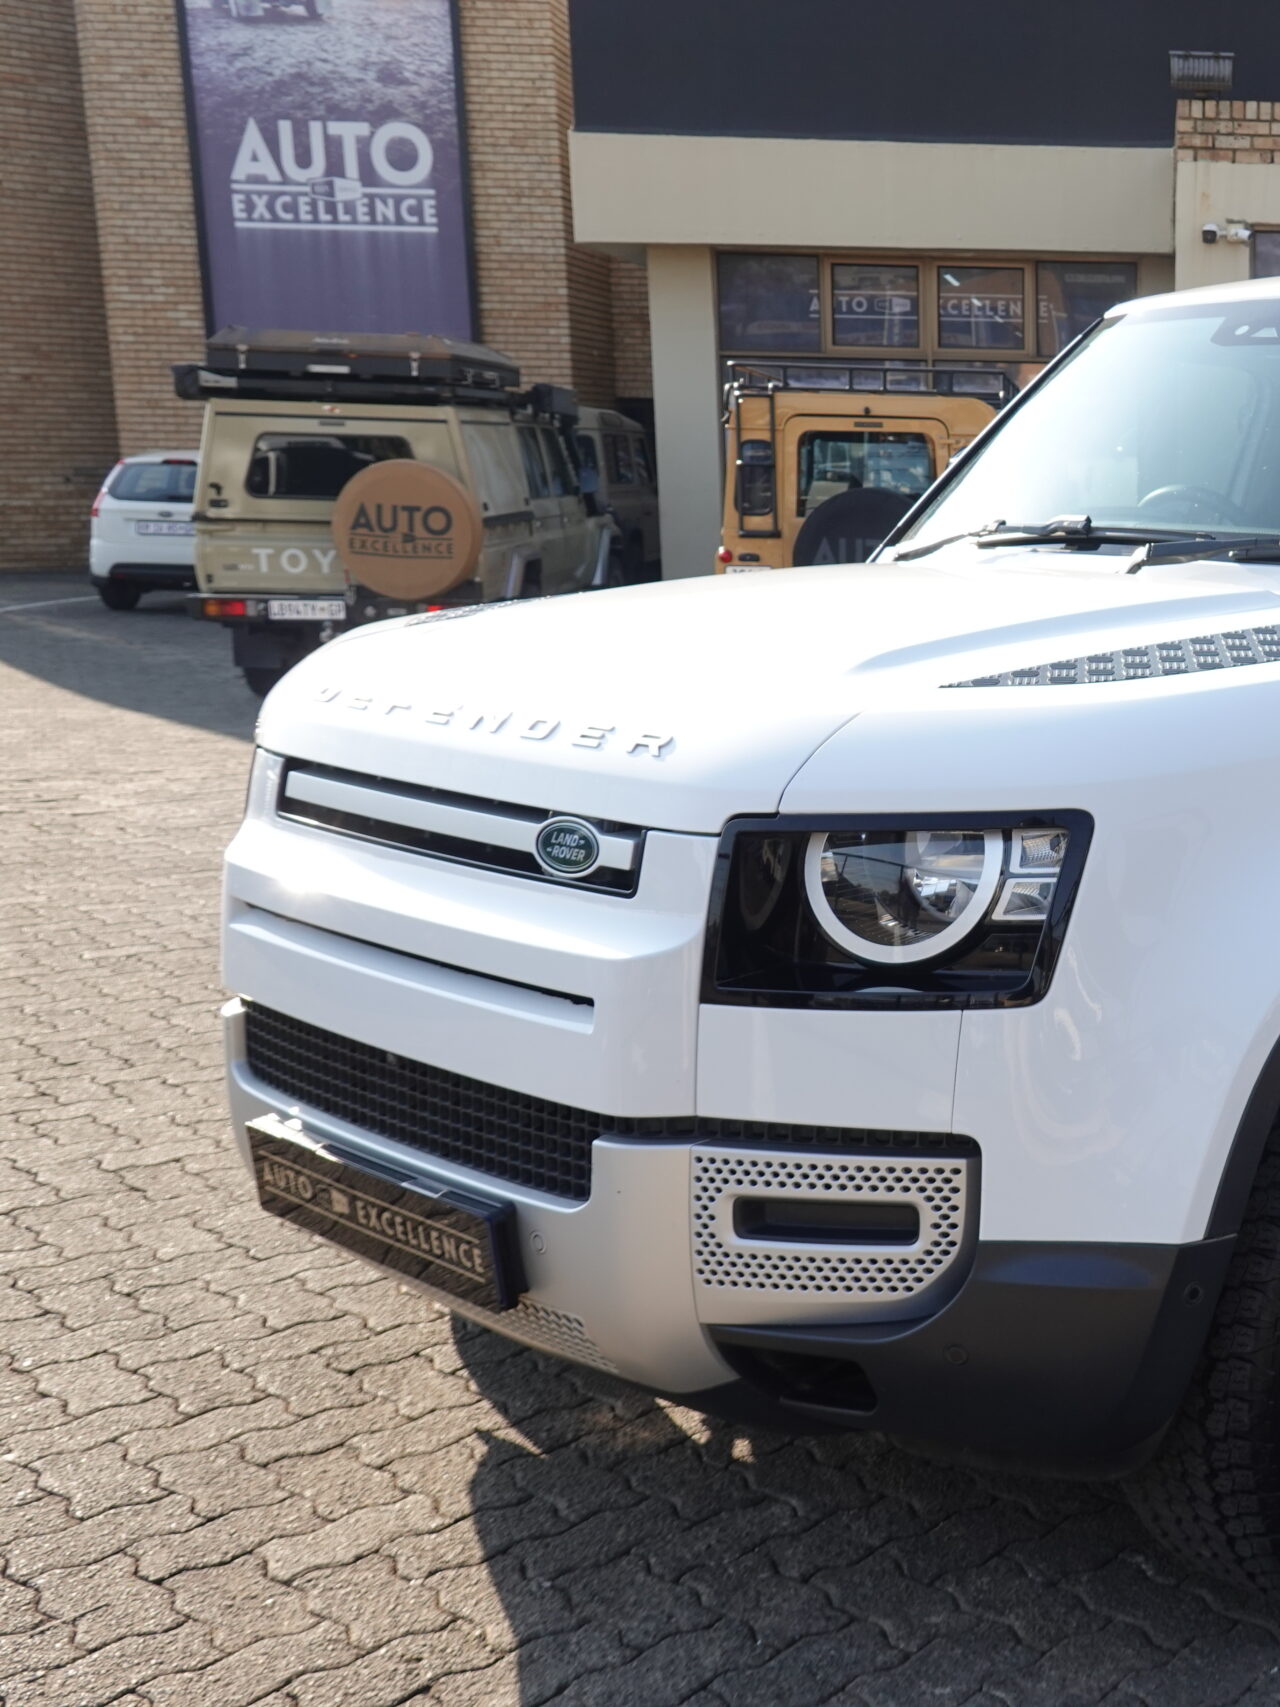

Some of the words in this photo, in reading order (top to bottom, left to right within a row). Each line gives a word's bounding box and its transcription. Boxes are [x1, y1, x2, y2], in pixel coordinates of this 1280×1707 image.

[230, 117, 434, 186] AUTO
[231, 193, 438, 224] EXCELLENCE
[809, 295, 868, 313] ATO
[351, 502, 454, 536] AUTO
[349, 536, 455, 555] EXCELLENCE
[313, 687, 675, 758] DEFENDER
[550, 831, 580, 848] LAND
[551, 845, 586, 863] ROVER
[261, 1160, 315, 1201] AUTO
[355, 1200, 486, 1274] EXCELLENCE
